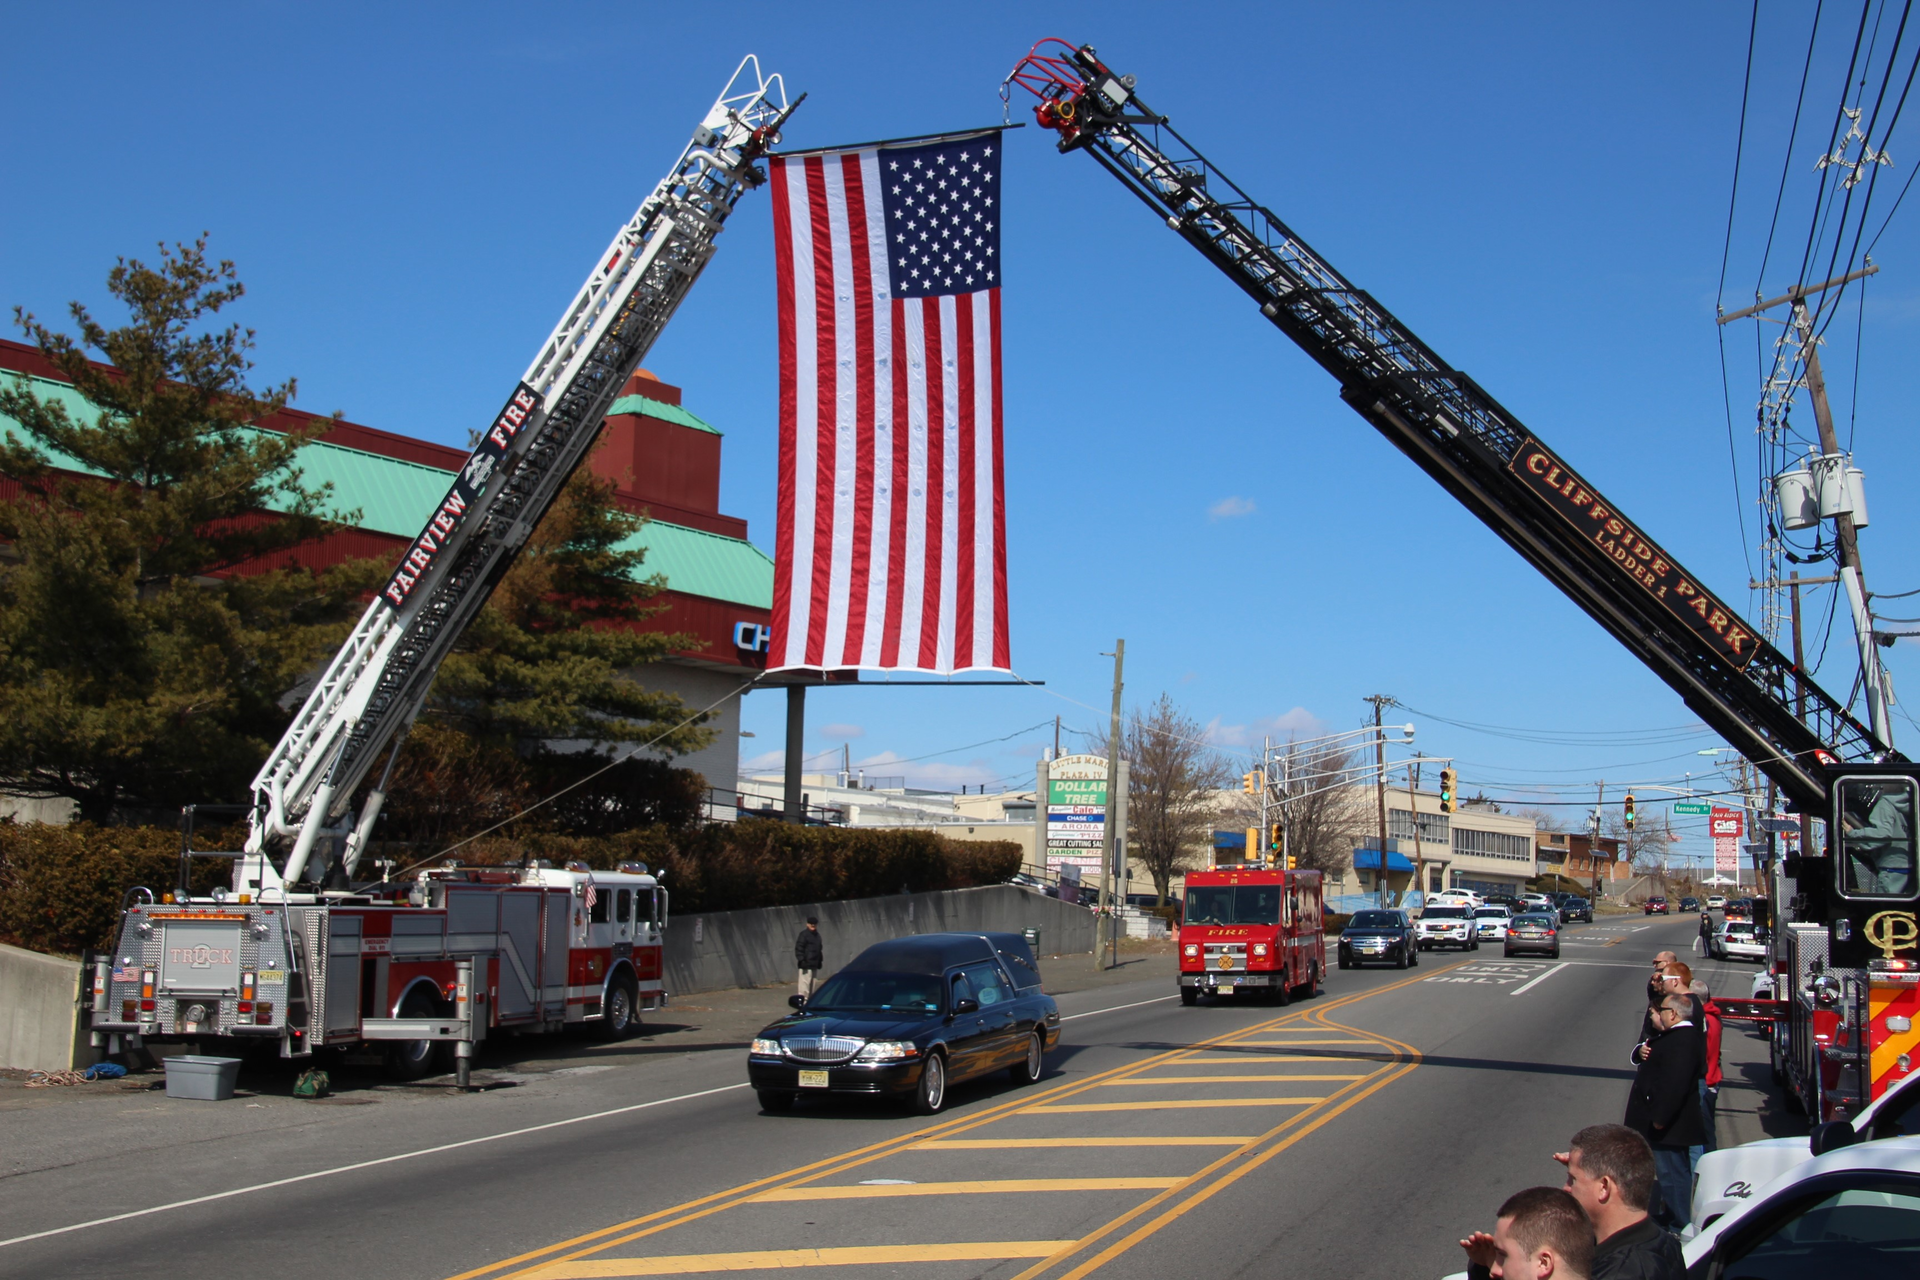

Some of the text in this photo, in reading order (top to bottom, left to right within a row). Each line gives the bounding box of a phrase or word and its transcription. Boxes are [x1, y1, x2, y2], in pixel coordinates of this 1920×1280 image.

[386, 388, 536, 605] FAIRVIEW FIRE
[1526, 453, 1751, 654] CLIFFSIDE PARK
[1594, 529, 1668, 599] LADDER 1
[733, 621, 771, 653] CH
[1050, 756, 1081, 770] LITTLE
[1060, 771, 1103, 779] PLAZA IV
[1055, 781, 1107, 792] DOLLAR
[1064, 794, 1097, 805] TREE
[1714, 820, 1737, 830] CVS
[1207, 928, 1249, 936] FIRE
[170, 947, 233, 965] TRUCK
[1422, 977, 1519, 985] ONLY
